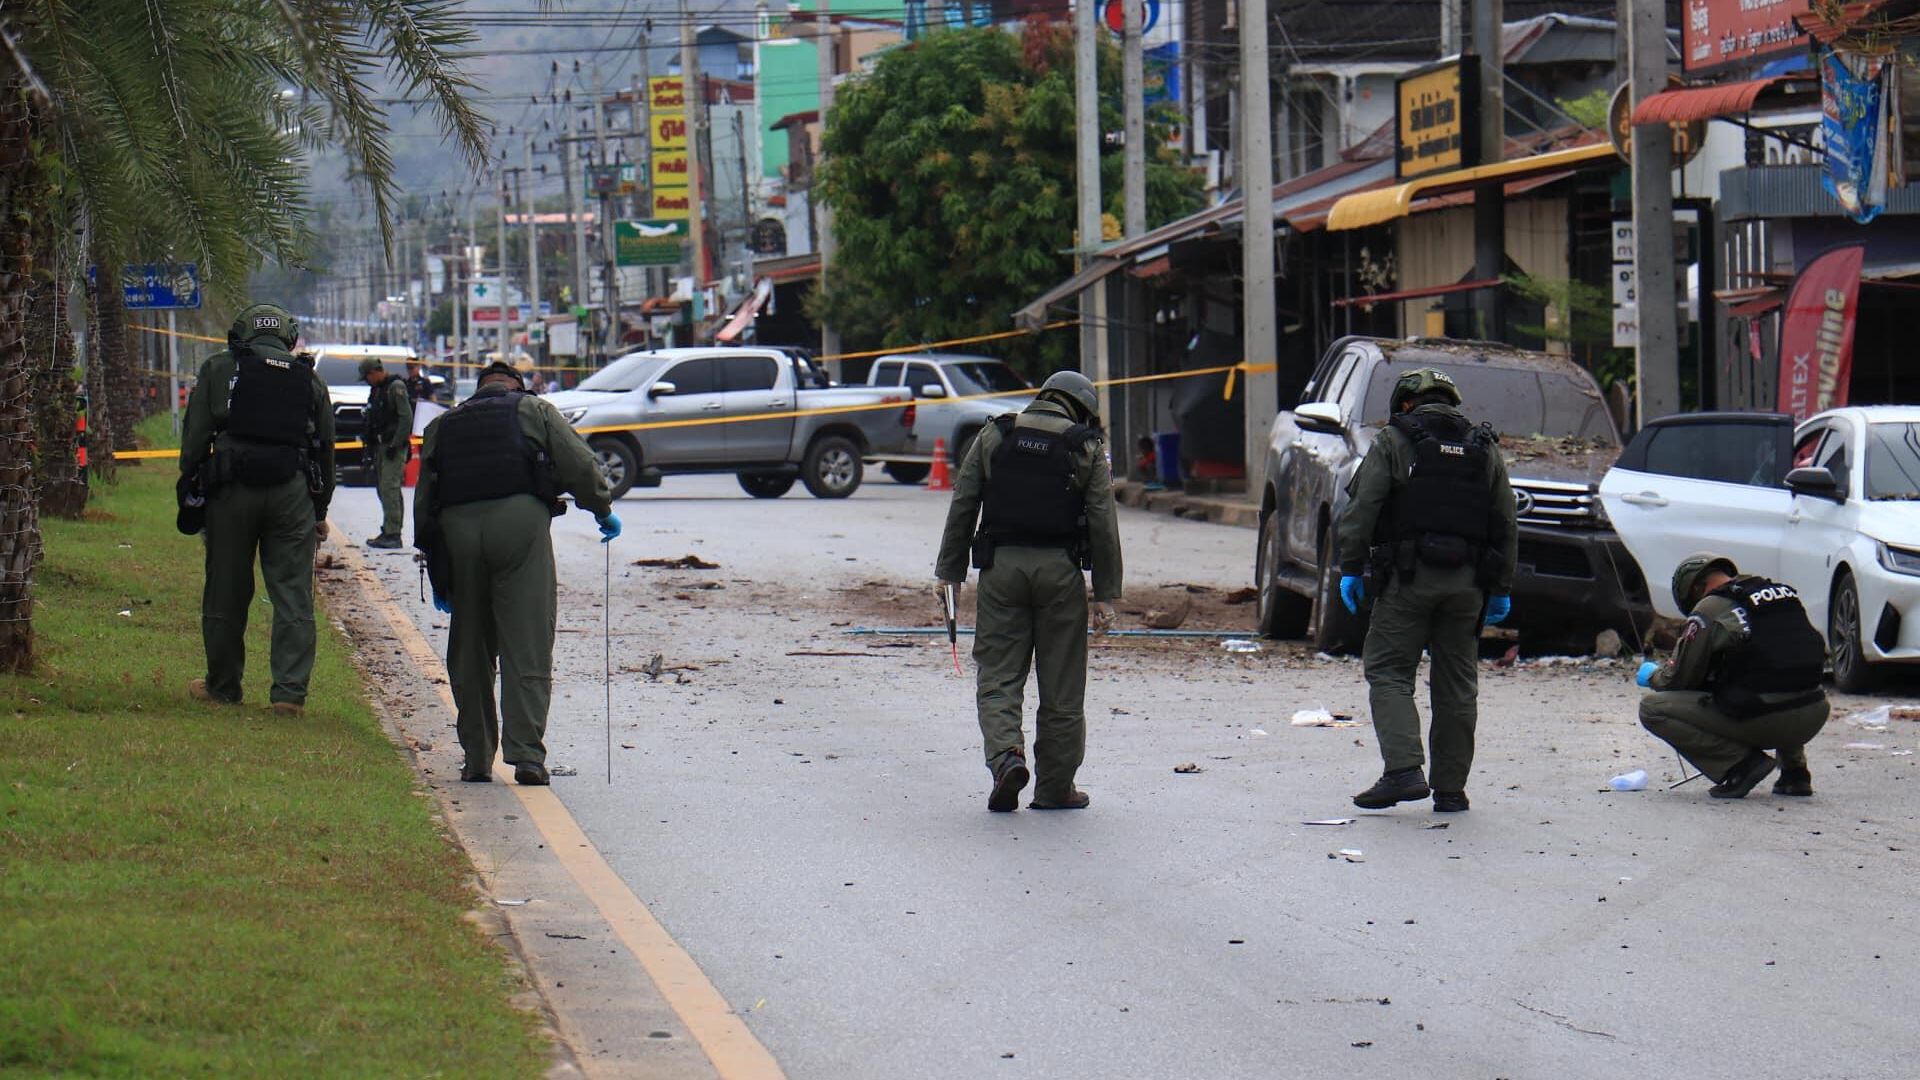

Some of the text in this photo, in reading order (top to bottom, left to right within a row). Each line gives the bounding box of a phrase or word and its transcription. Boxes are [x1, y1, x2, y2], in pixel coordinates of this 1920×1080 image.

[256, 317, 279, 328] EOD
[1816, 288, 1846, 412] avoline
[266, 358, 290, 369] POLICE
[1791, 351, 1810, 424] ALTEX
[1018, 439, 1049, 451] POLICE
[1440, 444, 1464, 455] POLICE
[1750, 586, 1799, 606] POLIC
